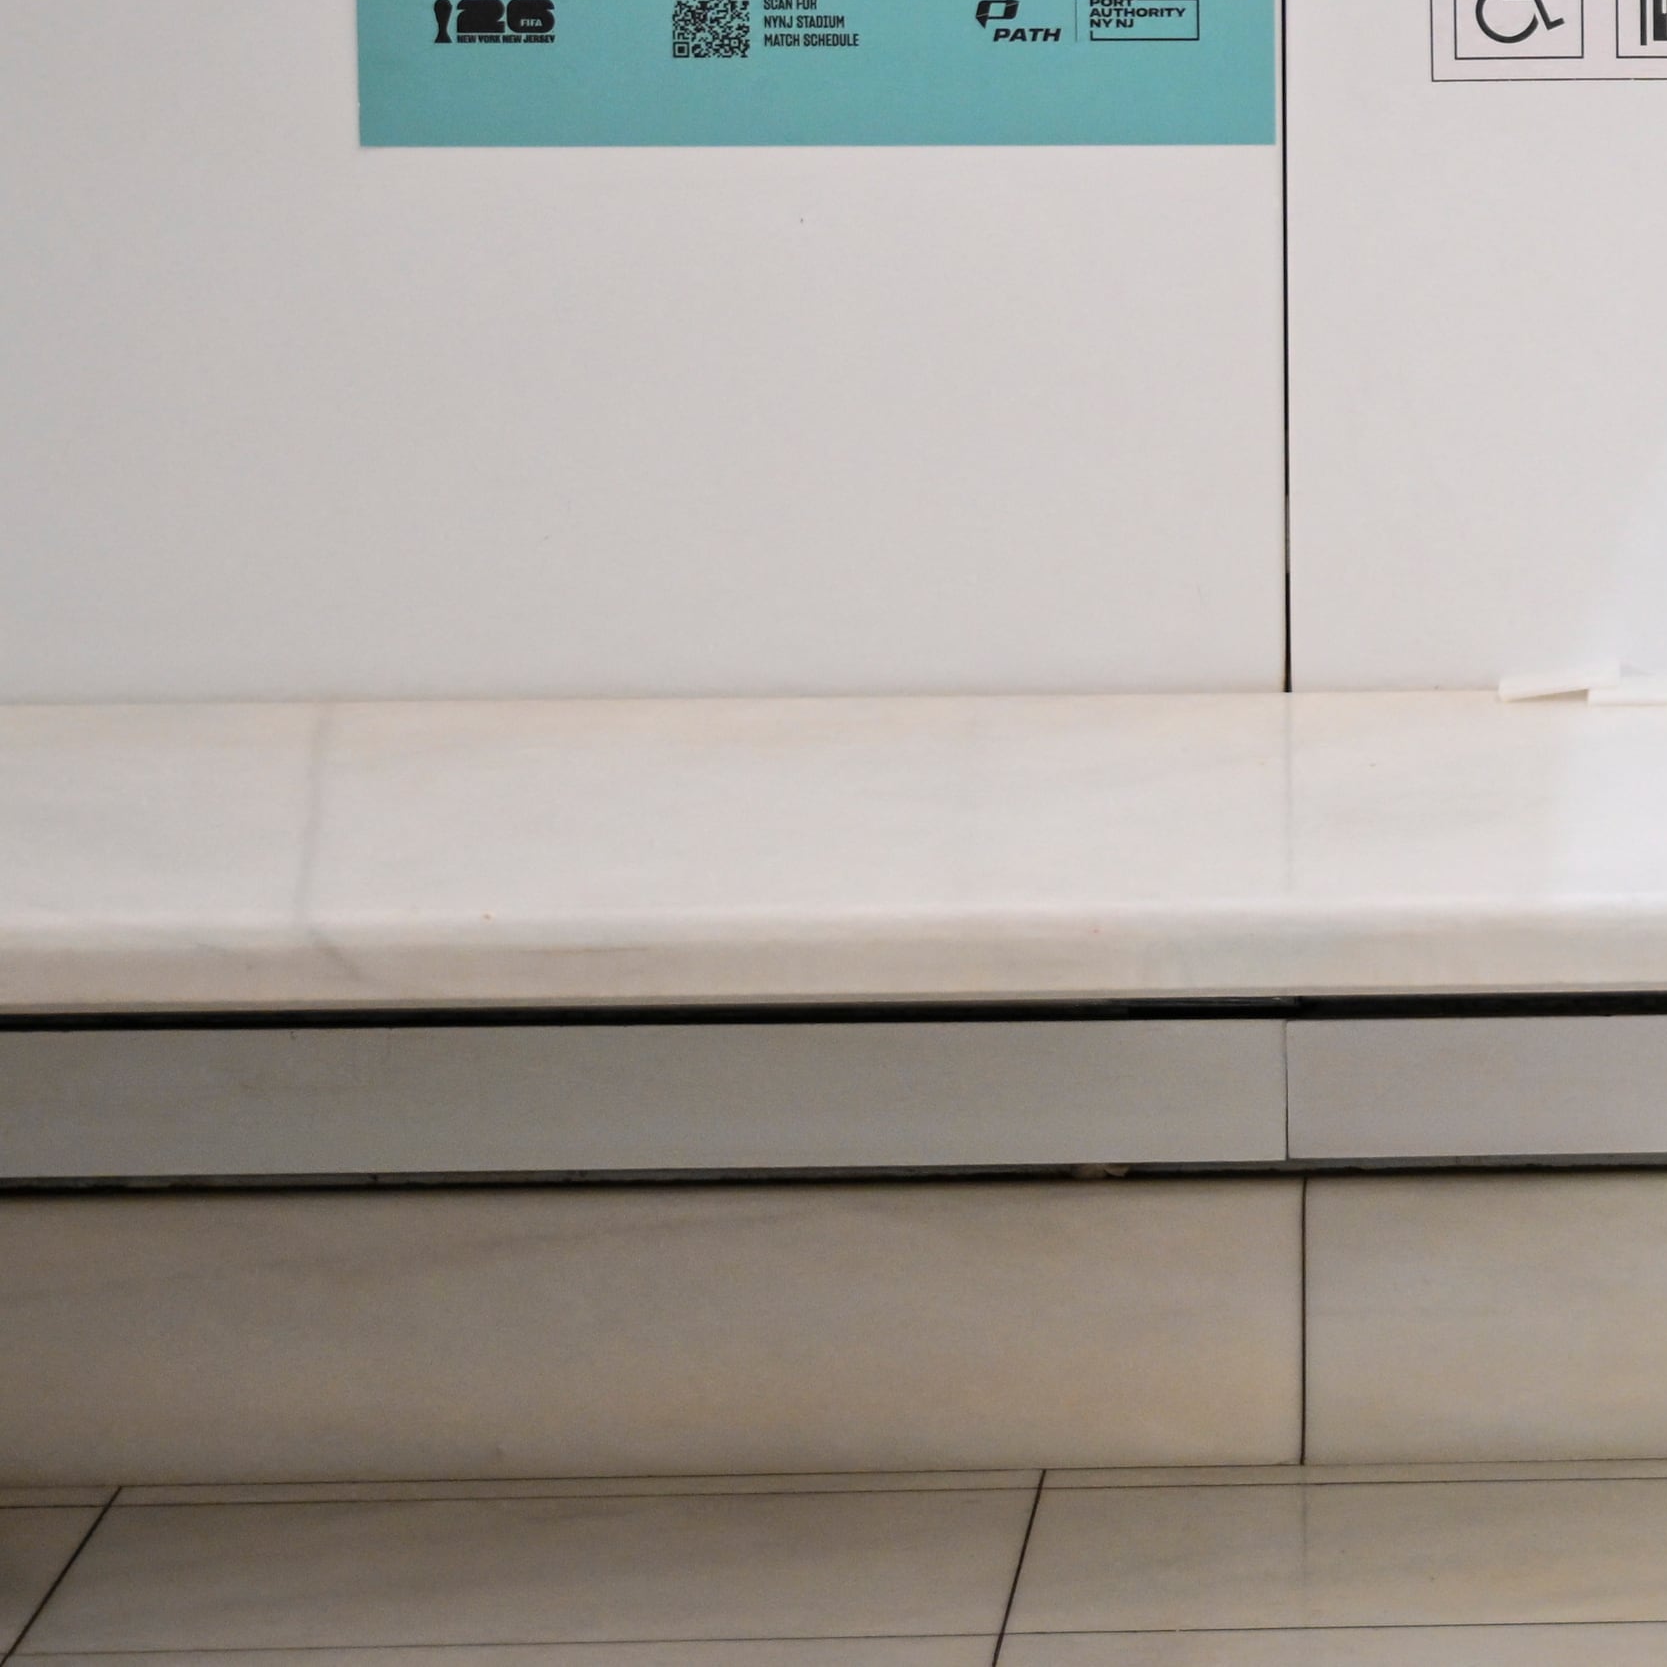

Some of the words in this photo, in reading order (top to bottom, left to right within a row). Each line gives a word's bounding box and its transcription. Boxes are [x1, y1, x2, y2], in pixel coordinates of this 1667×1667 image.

[1090, 8, 1185, 17] AUTHORITY
[520, 18, 543, 27] FIFA
[764, 15, 793, 28] NYNJ
[796, 15, 844, 28] STADIUM
[1090, 19, 1113, 28] NY
[1116, 19, 1133, 28] NJ
[479, 35, 500, 43] YORK
[523, 35, 555, 43] JERSEY
[993, 28, 1061, 42] PATH
[764, 34, 800, 47] MATCH
[803, 33, 859, 47] SCHEDULE
